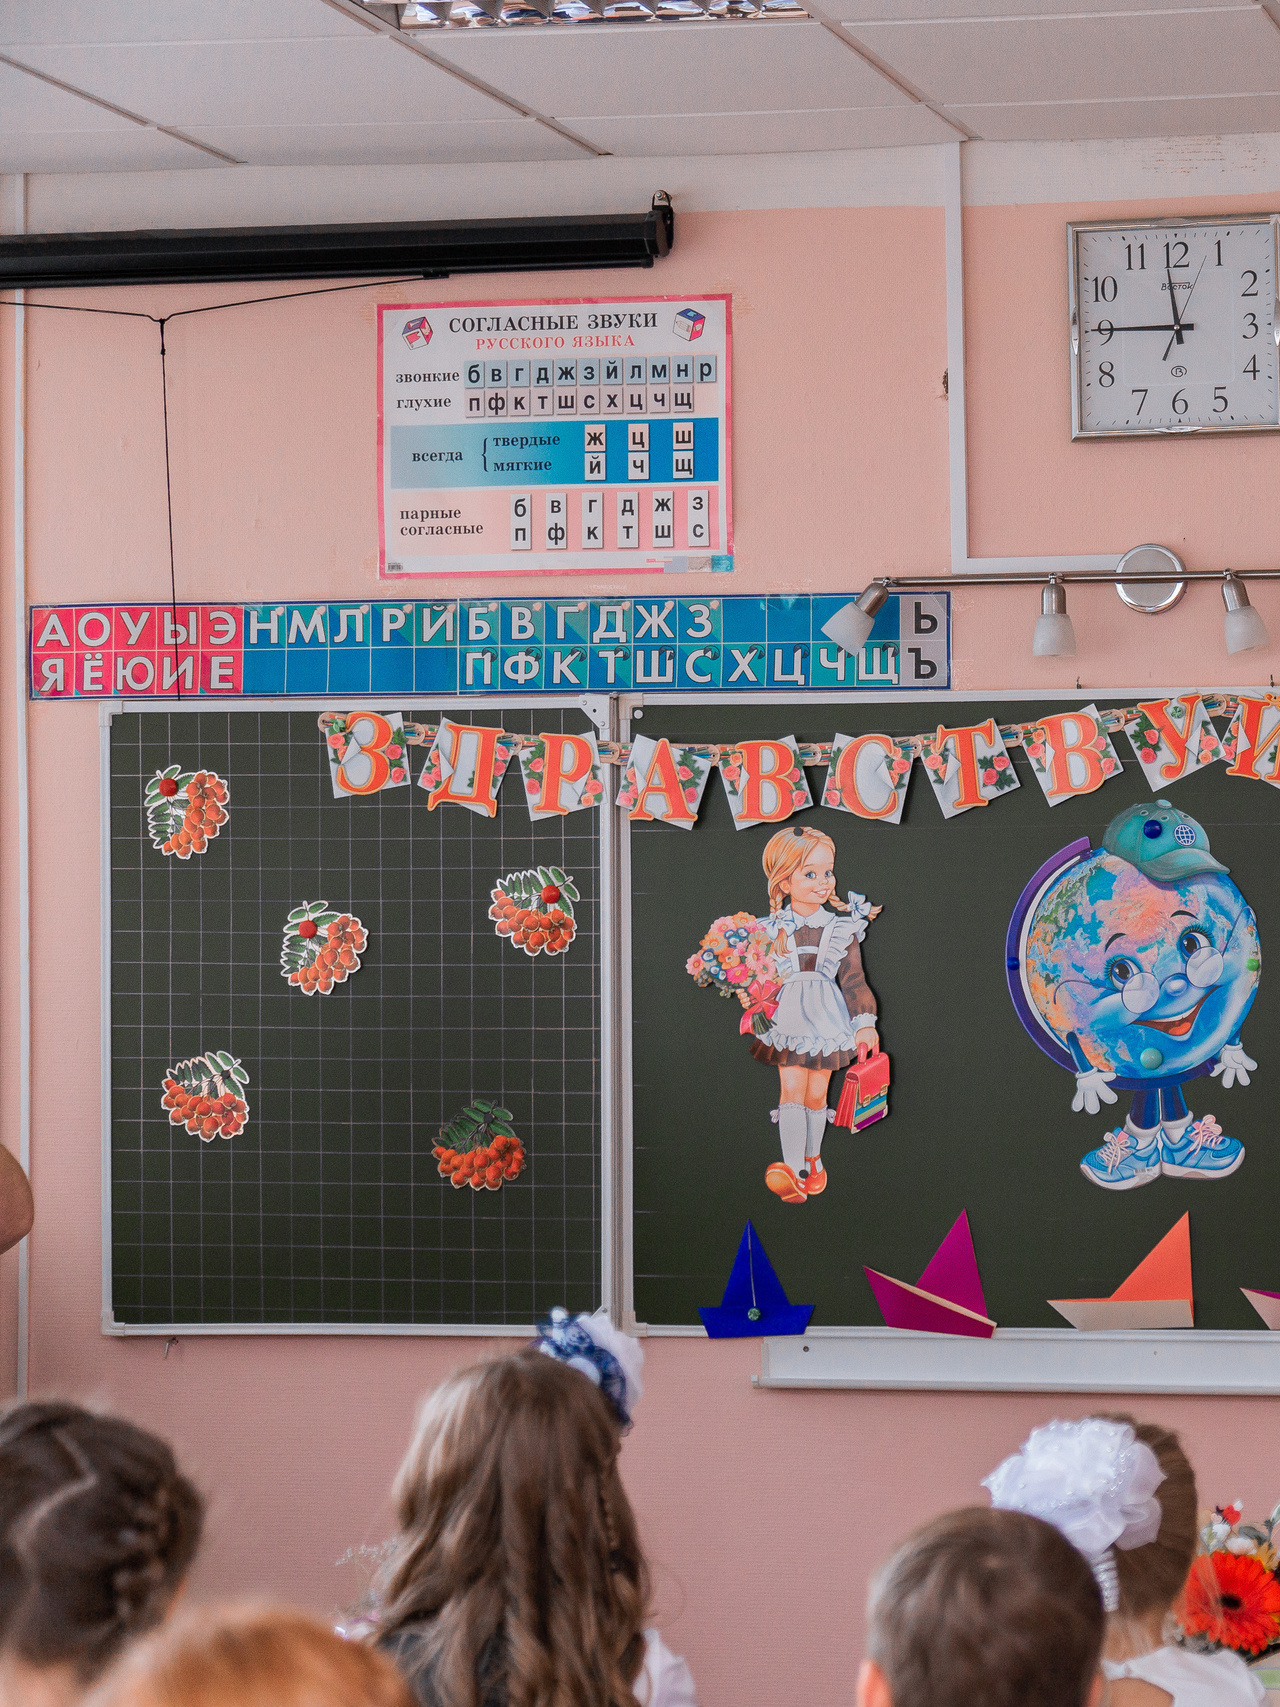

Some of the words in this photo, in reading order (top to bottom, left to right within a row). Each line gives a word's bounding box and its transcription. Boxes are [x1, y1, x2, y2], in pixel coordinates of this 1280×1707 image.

[1125, 243, 1146, 270] 11
[1164, 242, 1189, 268] 12
[1215, 240, 1222, 266] 1
[1093, 276, 1117, 302] 10
[1241, 270, 1258, 296] 2
[450, 315, 578, 332] СОГЛАСНЫЕ
[588, 313, 657, 329] ЗВУКИ
[1097, 319, 1114, 346] 9
[1243, 313, 1258, 339] 3
[476, 337, 564, 349] РУССКОГО
[572, 335, 634, 347] ЯЗЫКА
[396, 372, 459, 383] звонкие
[468, 364, 480, 383] б
[492, 369, 502, 382] в
[516, 368, 523, 381] г
[537, 368, 549, 383] д
[558, 367, 575, 380] ж
[584, 366, 594, 380] з
[607, 361, 617, 379] й
[631, 365, 641, 379] л
[652, 365, 666, 378] м
[677, 364, 688, 377] н
[700, 363, 711, 381] р
[1099, 362, 1114, 387] 8
[1243, 354, 1260, 380] 4
[397, 398, 451, 411] глухие
[470, 398, 479, 411] п
[488, 393, 505, 414] ф
[515, 397, 525, 410] к
[538, 396, 548, 409] т
[559, 396, 574, 409] ш
[584, 395, 594, 408] с
[607, 394, 617, 407] х
[630, 394, 642, 410] ц
[654, 393, 665, 406] ч
[675, 393, 691, 409] щ
[1132, 389, 1148, 415] 7
[1172, 389, 1188, 414] 6
[1213, 387, 1228, 412] 5
[493, 436, 560, 447] твердые
[413, 452, 463, 462] всегда
[494, 461, 552, 471] мягкие
[400, 510, 461, 522] парные
[401, 525, 483, 535] согласные
[36, 613, 70, 647] А
[77, 611, 111, 646] О
[120, 611, 150, 645] У
[163, 611, 197, 645] Ы
[209, 611, 237, 644] Э
[250, 611, 279, 644] Н
[288, 610, 327, 644] М
[333, 609, 364, 642] Л
[382, 607, 406, 642] Р
[423, 605, 454, 641] Й
[468, 607, 491, 641] Б
[511, 606, 536, 640] В
[556, 606, 581, 639] Г
[593, 605, 627, 643] Д
[634, 604, 675, 638] Ж
[686, 604, 713, 638] З
[914, 602, 938, 634] Ь
[39, 657, 65, 692] Я
[83, 653, 103, 691] Ё
[116, 656, 155, 691] Ю
[162, 656, 193, 690] И
[210, 656, 234, 689] Е
[465, 652, 492, 685] П
[503, 651, 540, 684] Ф
[553, 651, 581, 684] К
[598, 651, 624, 684] Т
[632, 650, 674, 682] Ш
[685, 649, 712, 683] С
[728, 648, 759, 682] Х
[774, 648, 805, 685] Ц
[819, 648, 846, 681] Ч
[858, 647, 898, 685] Щ
[908, 648, 938, 680] Ъ
